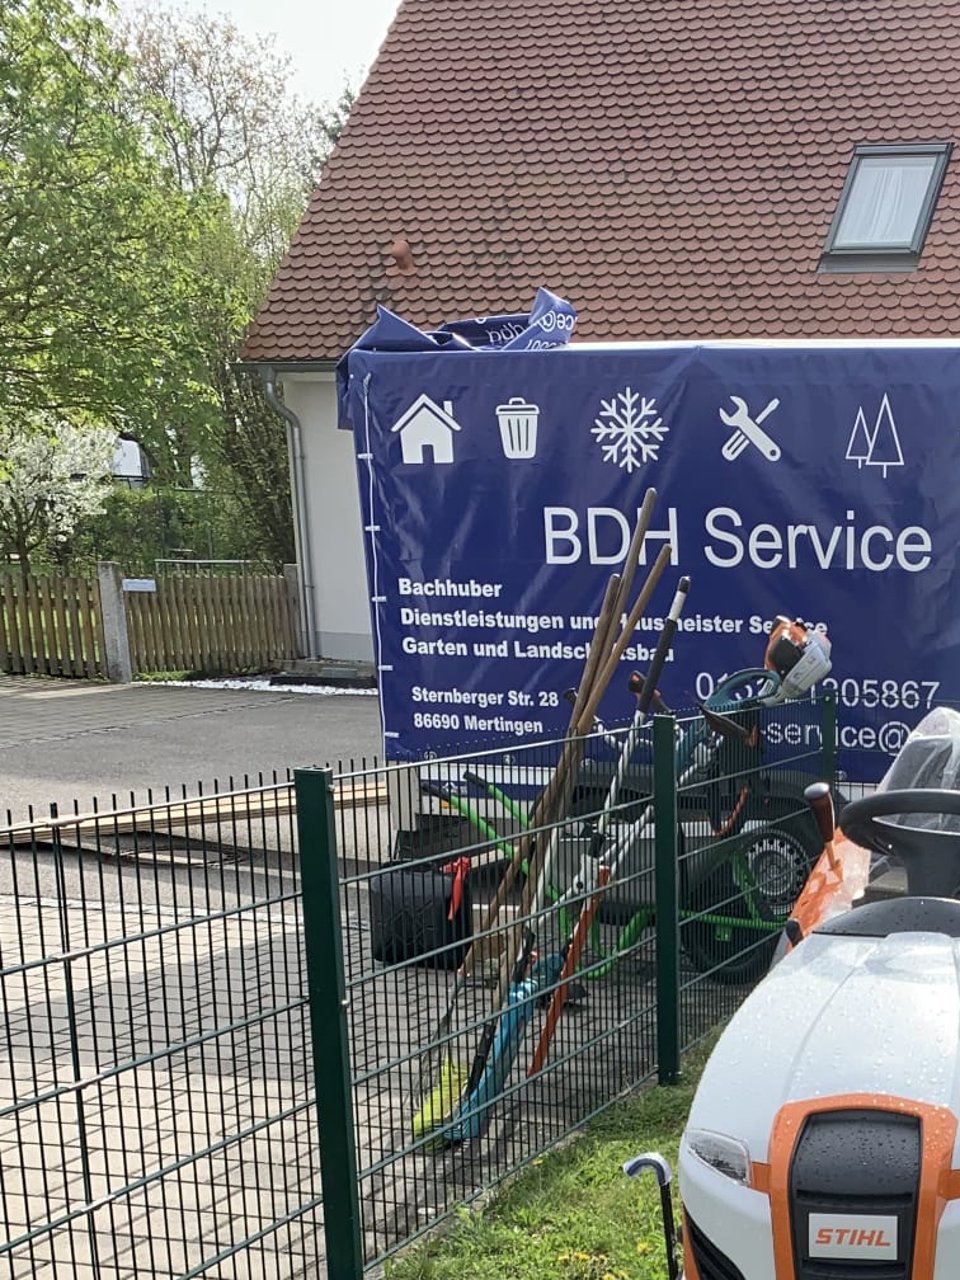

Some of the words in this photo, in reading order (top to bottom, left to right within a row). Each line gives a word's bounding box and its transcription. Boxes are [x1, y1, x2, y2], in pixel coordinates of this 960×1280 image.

[543, 507, 679, 566] BDH
[704, 507, 932, 572] Service
[398, 578, 502, 598] Bachhuber
[401, 608, 564, 633] Dienstleistungen
[402, 638, 468, 656] Garten
[474, 641, 508, 658] und
[412, 686, 504, 708] Sternberger
[508, 690, 534, 706] Str.
[539, 691, 559, 707] 28
[414, 712, 459, 729] 86690
[464, 715, 543, 736] Mertingen
[815, 1228, 891, 1247] STIHL
